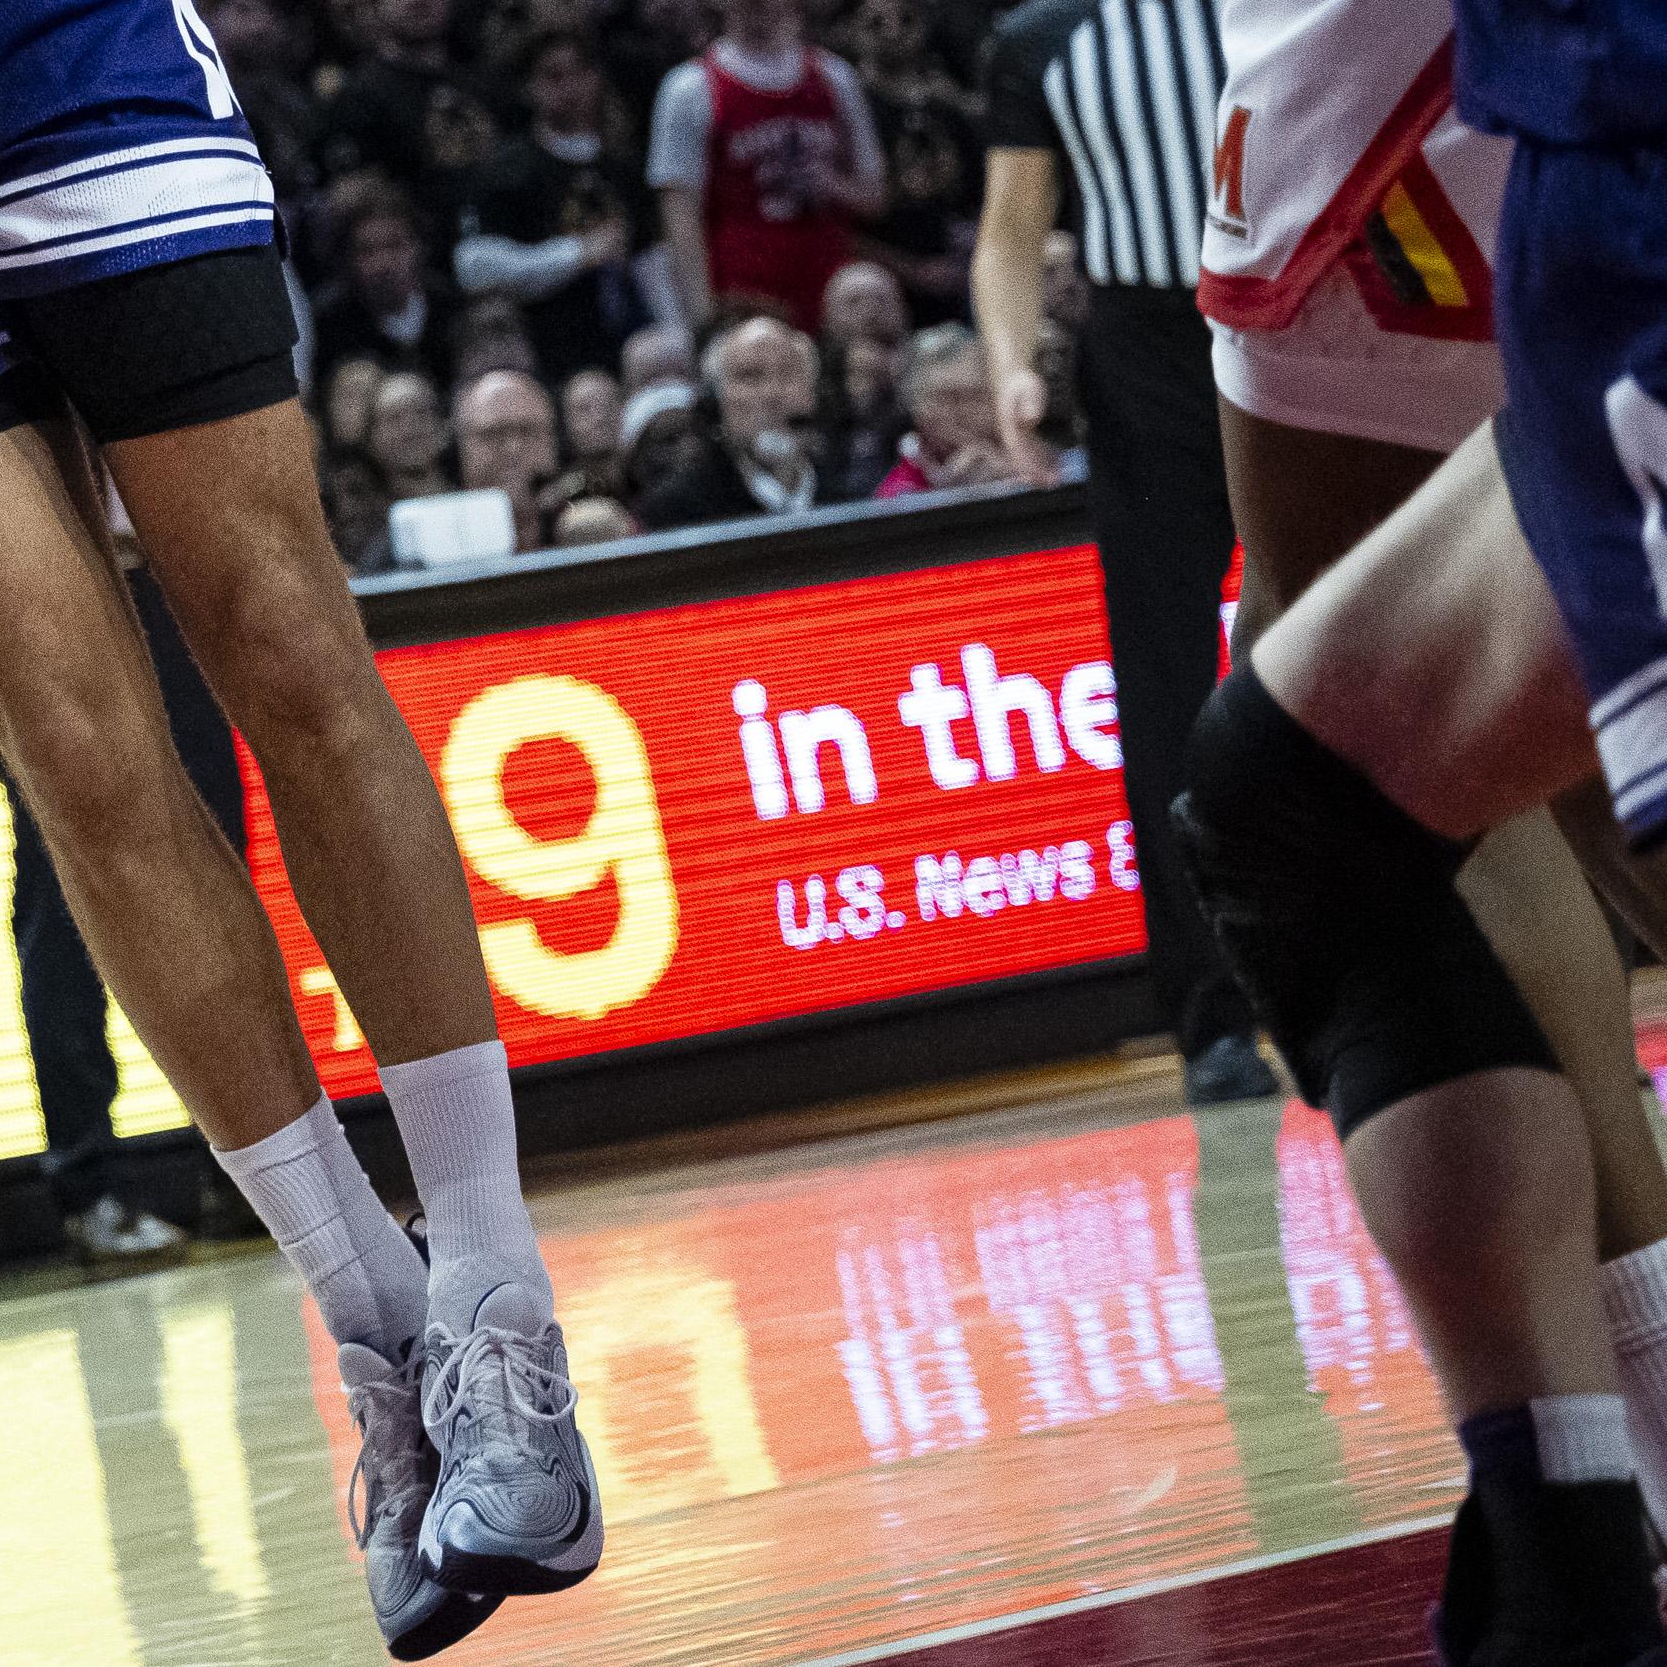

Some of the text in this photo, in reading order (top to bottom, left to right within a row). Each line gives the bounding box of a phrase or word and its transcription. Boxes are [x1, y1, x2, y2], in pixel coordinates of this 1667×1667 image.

[732, 643, 1124, 820] in the
[776, 864, 907, 950] U.S.
[914, 839, 1097, 922] News
